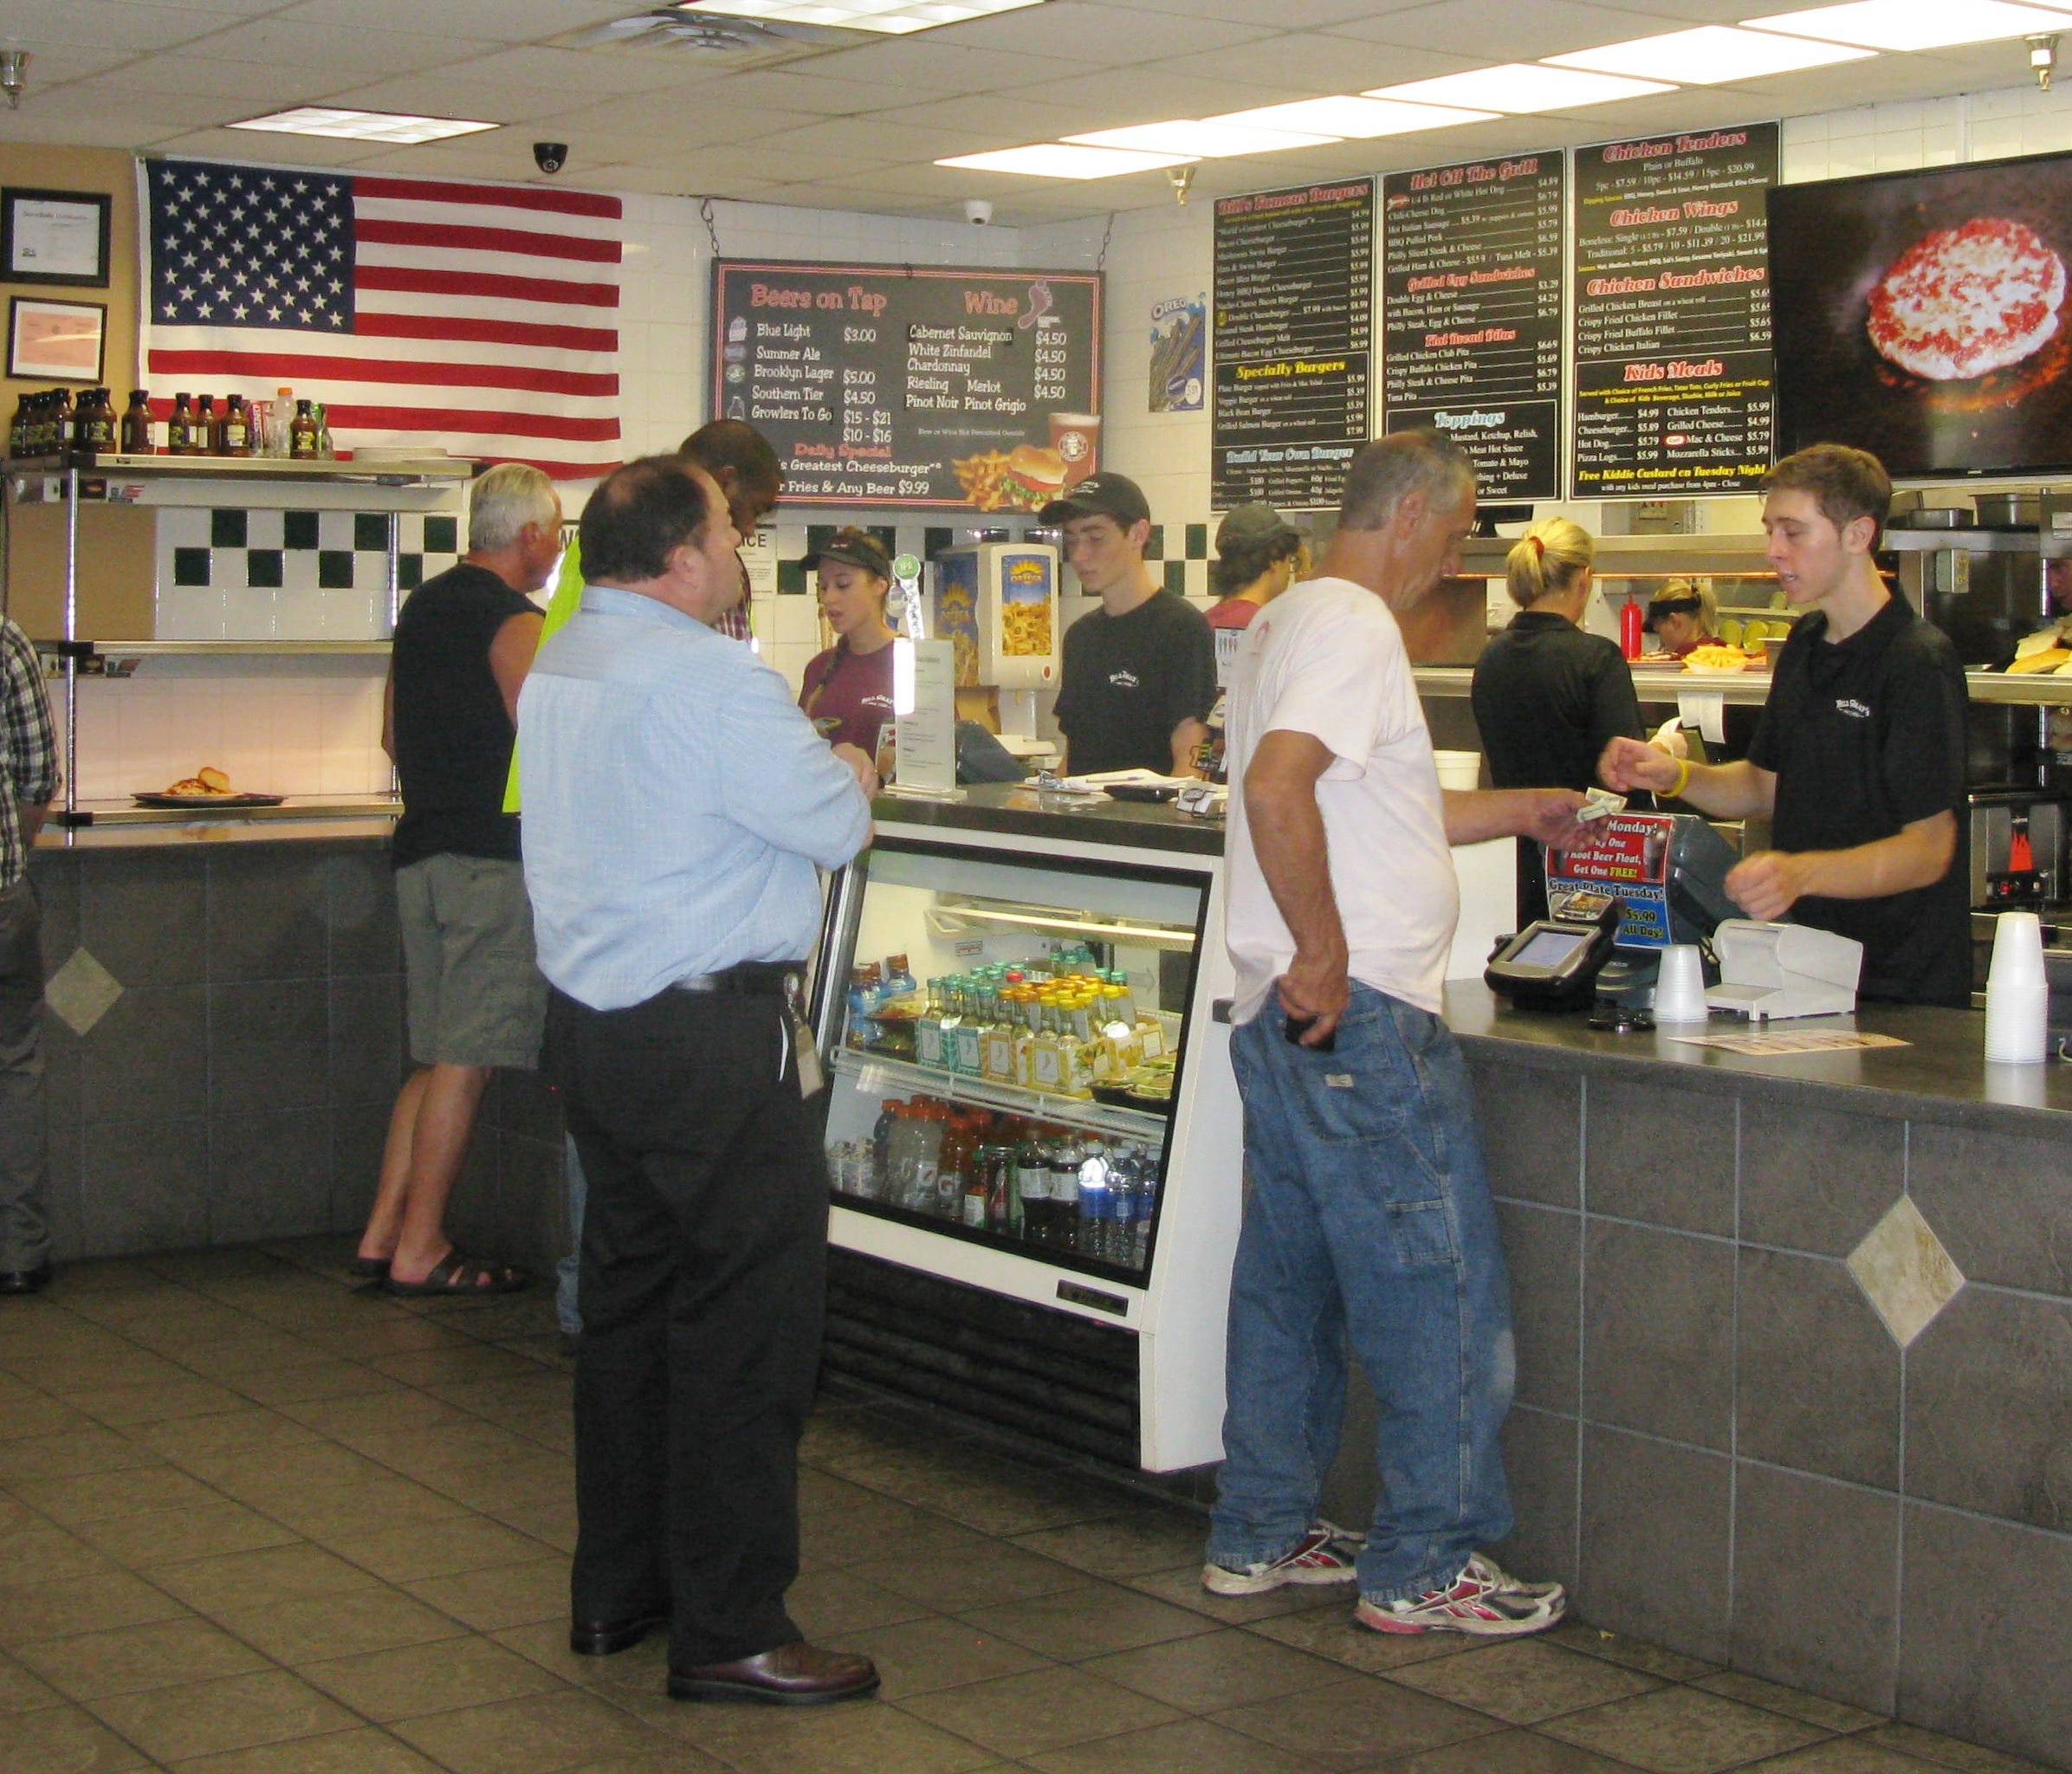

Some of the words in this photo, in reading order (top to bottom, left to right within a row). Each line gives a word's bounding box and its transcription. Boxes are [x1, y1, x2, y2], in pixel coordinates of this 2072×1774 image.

[1603, 142, 1673, 162] Chicken
[1676, 131, 1747, 153] Tenders
[1610, 207, 1680, 227] Chicken
[1683, 200, 1739, 219] Wings
[1586, 277, 1656, 296] Chicken
[1658, 266, 1765, 289] Sandwiches
[750, 283, 812, 308] Beers
[816, 293, 844, 309] on
[848, 285, 887, 317] Tap
[964, 291, 1018, 314] Wine
[1151, 297, 1188, 320] OREO
[1606, 301, 1635, 312] Chicken
[756, 323, 780, 337] Blue
[783, 323, 811, 341] Light
[844, 327, 877, 343] $3.00
[910, 325, 955, 340] Cabernet
[958, 326, 1013, 344] Sauvignon
[1035, 330, 1067, 346] $4.50
[756, 346, 800, 360] Summer
[802, 347, 821, 360] Ale
[909, 343, 941, 357] White
[942, 344, 992, 359] Zinfandel
[1034, 348, 1066, 365] $4.50
[754, 364, 803, 382] Brooklyn
[805, 366, 834, 383] Lager
[907, 358, 970, 376] Chardonnay
[1033, 366, 1066, 383] $4.50
[1236, 362, 1293, 379] Specialty
[1294, 359, 1347, 374] Burgers
[1623, 363, 1665, 382] Kids
[1667, 360, 1724, 380] Meals
[843, 369, 876, 385] $5.00
[907, 376, 949, 394] Riesling
[967, 379, 1001, 393] Merlot
[752, 385, 800, 400] Southern
[803, 387, 824, 401] Tier
[844, 388, 876, 405] $4.50
[1033, 385, 1065, 400] $4.50
[906, 394, 934, 409] Pinot
[936, 395, 959, 410] Noir
[964, 397, 992, 411] Pinot
[994, 398, 1026, 415] Grigio
[1667, 406, 1700, 418] Chicken
[1702, 404, 1731, 415] Tenders
[1747, 401, 1770, 412] $5.99
[752, 405, 800, 420] Growlers
[801, 406, 815, 421] To
[817, 407, 832, 422] Go
[843, 410, 863, 426] $15
[872, 410, 891, 427] $21
[1434, 410, 1506, 430] Toppings
[1577, 411, 1619, 422] Hamburger
[1637, 409, 1659, 419] $4.99
[1577, 425, 1628, 437] Cheeseburger
[1667, 421, 1695, 431] Grilled
[1696, 420, 1725, 430] Cheese
[1747, 416, 1770, 427] $4.99
[843, 428, 863, 443] $10
[872, 429, 892, 444] $16
[1577, 439, 1592, 449] Hot
[1593, 439, 1609, 450] Dog
[1637, 437, 1660, 447] $5.79
[1687, 435, 1703, 444] Mac
[1706, 434, 1713, 444] &
[1714, 433, 1743, 443] Cheese
[1747, 431, 1770, 442] $5.79
[795, 443, 835, 459] Daily
[838, 443, 892, 460] Special
[1577, 453, 1597, 463] Pizza
[1637, 450, 1658, 461] $5.99
[1667, 450, 1709, 459] Mozzarella
[1745, 445, 1769, 456] $5.99
[790, 459, 843, 473] Greatest
[1578, 469, 1601, 482] Free
[1603, 468, 1635, 480] Kiddie
[1636, 468, 1676, 479] Custard
[1694, 466, 1736, 478] Tuesday
[1738, 464, 1765, 476] Night
[788, 481, 819, 494] Fries
[822, 480, 834, 493] &
[837, 482, 863, 496] Any
[866, 482, 896, 495] Beer
[898, 479, 929, 495] $9.99
[1607, 821, 1658, 835] Monday!
[1609, 838, 1626, 848] One
[1593, 851, 1613, 862] Beer
[1616, 852, 1641, 864] Float,
[1573, 864, 1590, 874] Get
[1590, 865, 1608, 876] One
[1609, 866, 1637, 878] FREE!
[1549, 878, 1579, 890] Great
[1614, 884, 1664, 902] Tuesday!
[1626, 909, 1656, 922] $5.99
[1623, 923, 1639, 935] All
[1640, 924, 1663, 939] Day!
